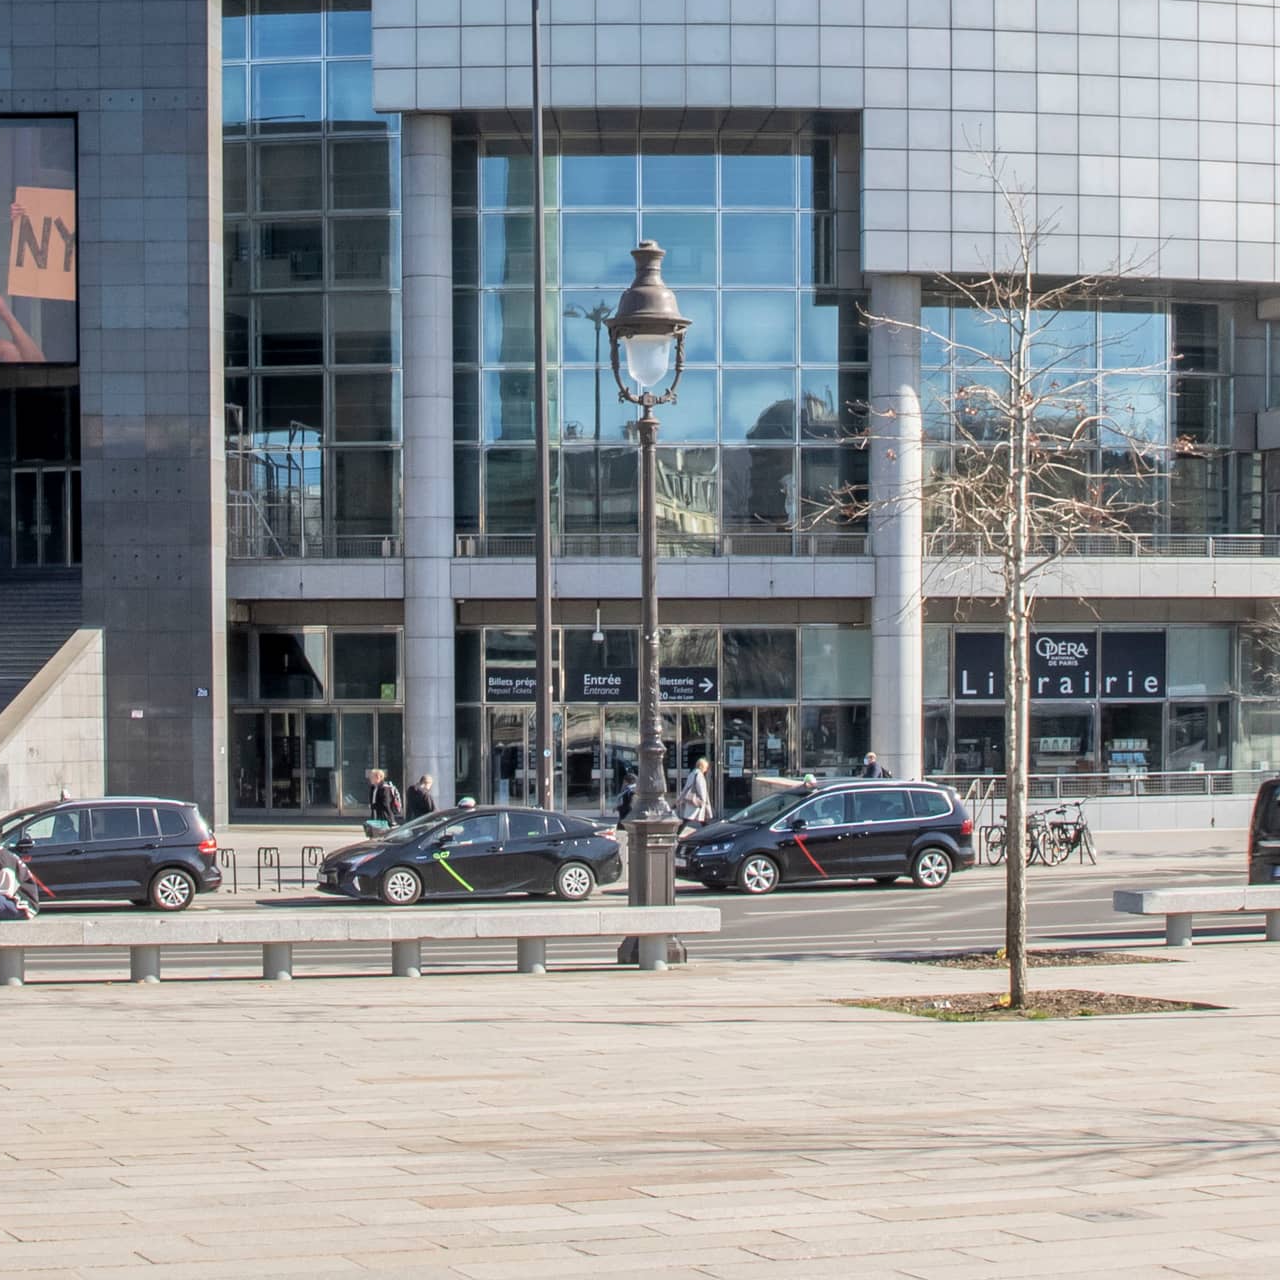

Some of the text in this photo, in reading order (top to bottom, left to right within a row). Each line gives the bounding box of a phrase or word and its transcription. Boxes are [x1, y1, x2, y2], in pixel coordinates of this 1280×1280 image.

[16, 214, 75, 272] NY
[1036, 637, 1088, 659] OPÉRA
[488, 677, 513, 686] Billets
[583, 674, 622, 685] Entrée
[660, 677, 694, 686] illetterie
[962, 670, 1158, 695] Lirairie
[583, 686, 620, 695] Entrance
[673, 686, 693, 694] Tickets
